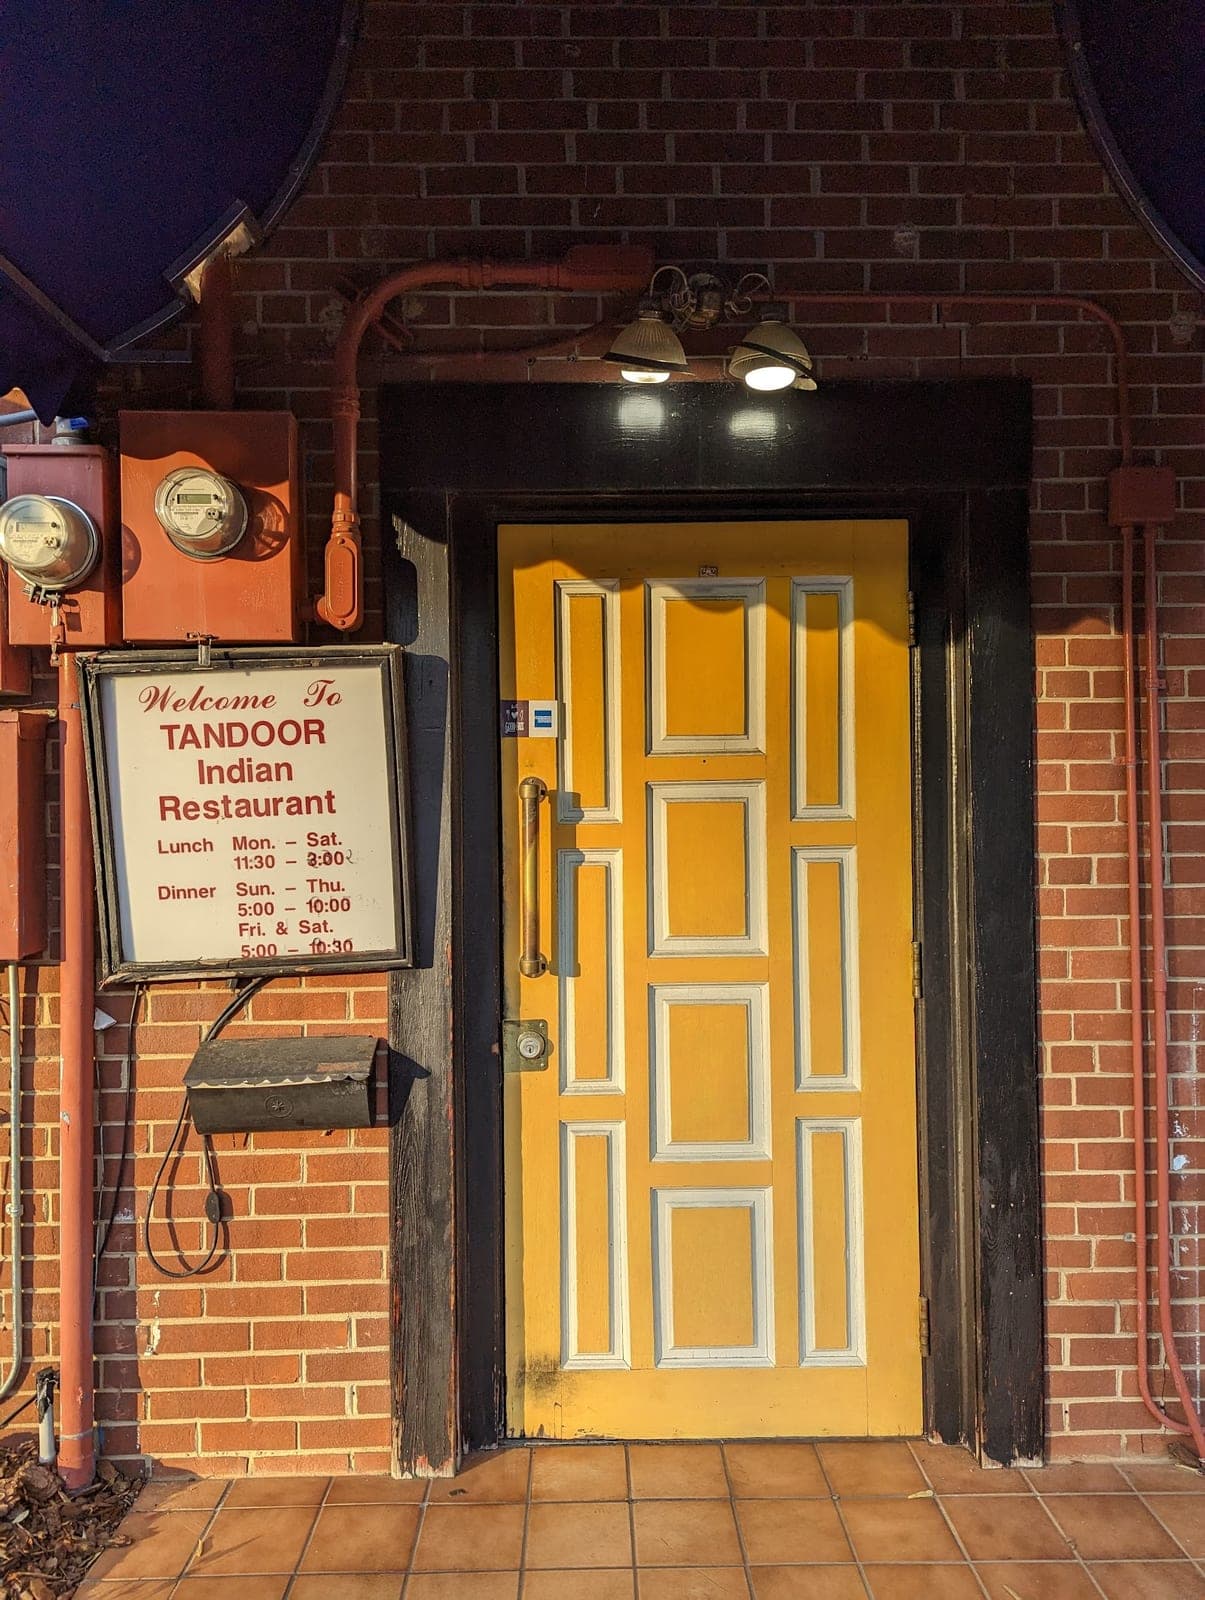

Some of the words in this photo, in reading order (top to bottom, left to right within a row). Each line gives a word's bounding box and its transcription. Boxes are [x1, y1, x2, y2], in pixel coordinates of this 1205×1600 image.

[138, 685, 277, 713] Welcome
[304, 679, 343, 708] To
[160, 719, 327, 750] TANDOOR
[197, 757, 294, 785] Indian
[159, 790, 337, 821] Restaurant
[157, 838, 214, 854] Lunch
[232, 836, 275, 851] Mon.
[306, 832, 342, 847] Sat.
[233, 854, 275, 870] 11:30
[157, 885, 217, 900] Dinner
[236, 882, 275, 897] Sun.
[306, 878, 345, 893] Thu.
[238, 902, 274, 917] 5:00
[306, 897, 351, 913] 10:00
[238, 922, 266, 937] Fri.
[276, 921, 288, 935] &
[299, 920, 333, 934] Sat.
[241, 943, 277, 958] 5:00
